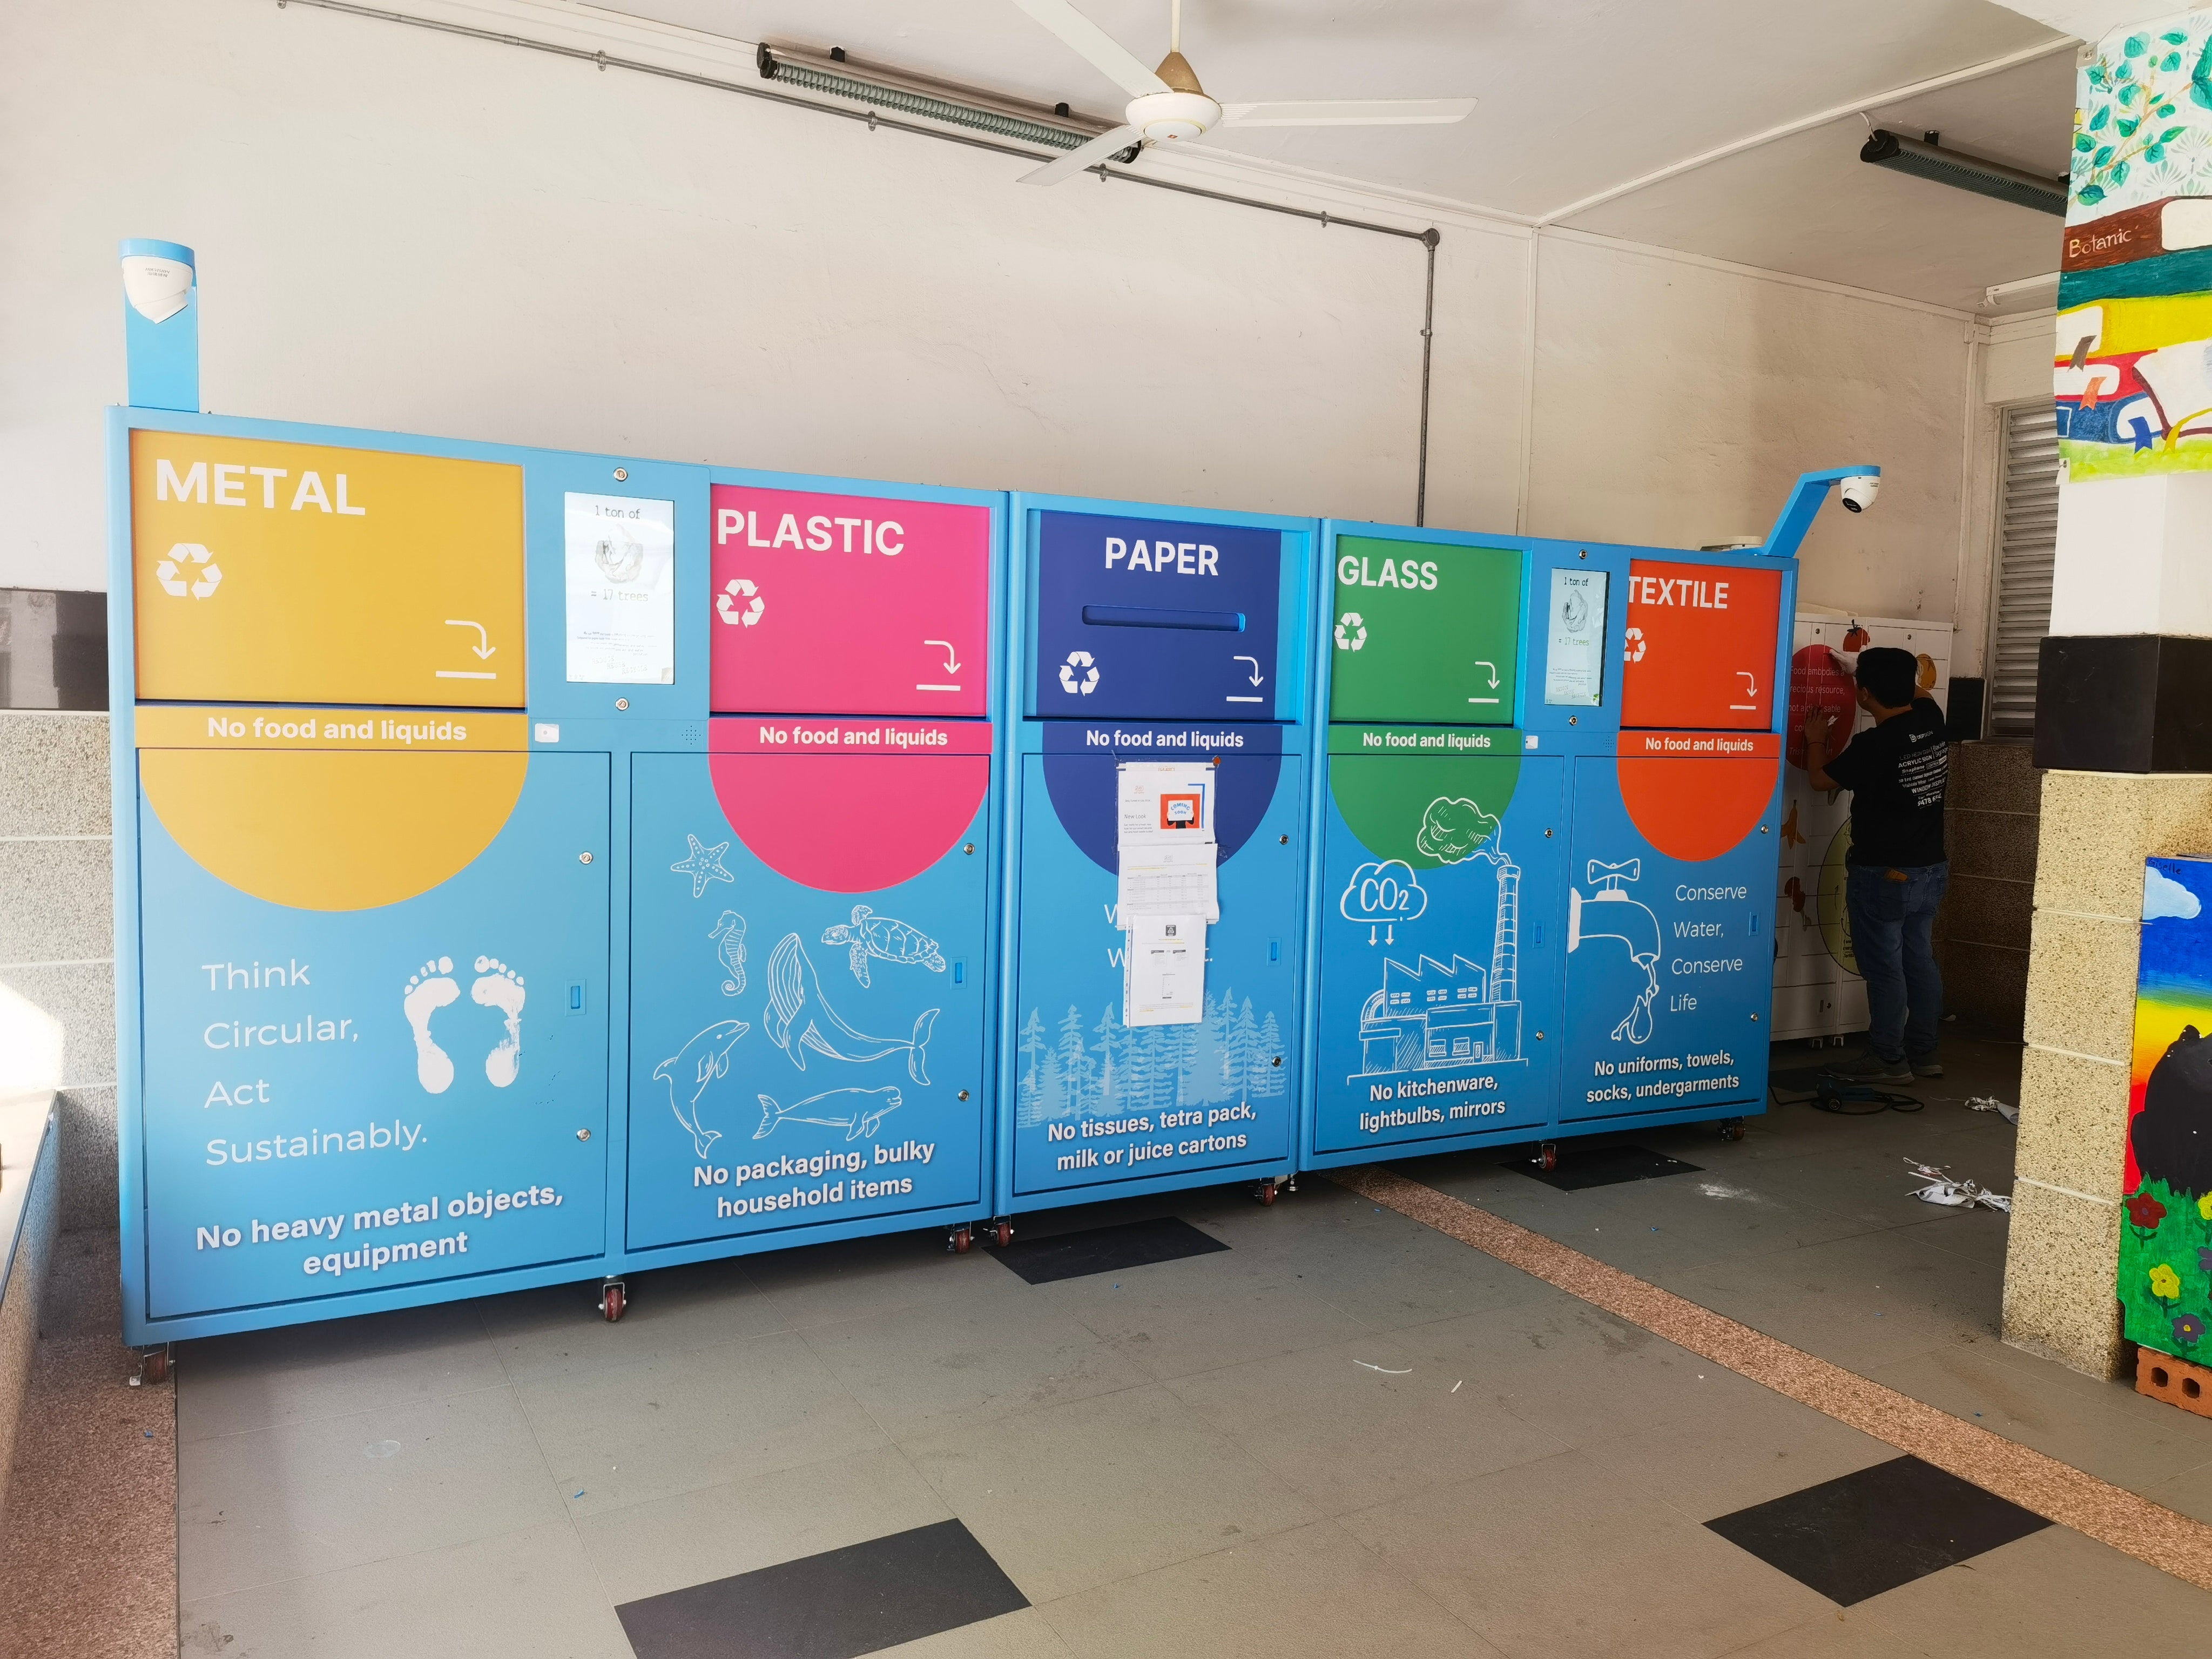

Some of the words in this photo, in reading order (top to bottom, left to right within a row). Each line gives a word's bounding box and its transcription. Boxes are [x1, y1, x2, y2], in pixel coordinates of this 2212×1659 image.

[2069, 228, 2132, 258] Botanic
[156, 458, 366, 515] METAL
[606, 507, 624, 518] ton
[629, 509, 640, 520] of
[718, 508, 905, 556] PLASTIC
[1105, 537, 1218, 576] PAPER
[1338, 555, 1438, 590] GLASS
[1570, 578, 1580, 586] ton
[1582, 578, 1589, 586] of
[603, 589, 614, 600] 17
[619, 590, 649, 602] trees
[1628, 576, 1729, 609] TEXTILE
[1564, 637, 1570, 645] 17
[1573, 638, 1589, 646] trees
[1808, 667, 1839, 676] embodies
[1790, 684, 1814, 693] recious
[1816, 686, 1845, 696] resource,
[208, 717, 245, 738] No
[253, 717, 316, 739] food
[323, 720, 373, 739] and
[381, 720, 467, 745] liquids
[759, 726, 787, 744] No
[792, 726, 838, 745] food
[844, 728, 880, 745] and
[885, 728, 948, 749] liquids
[1086, 730, 1110, 746] No
[1114, 730, 1152, 746] food
[1156, 731, 1186, 747] and
[1191, 731, 1243, 751] liquids
[1363, 732, 1382, 746] No
[1385, 732, 1417, 747] food
[1420, 734, 1445, 747] and
[1448, 733, 1491, 751] liquids
[1645, 737, 1661, 750] No
[1664, 737, 1690, 751] food
[1693, 738, 1714, 751] and
[1717, 738, 1754, 754] liquids
[1898, 758, 1922, 768] ACRYLIC
[1912, 784, 1931, 794] WINDOW
[1918, 798, 1932, 806] 9478
[1171, 802, 1190, 811] COMING
[1676, 885, 1747, 901] Conserve
[1674, 921, 1724, 938] Water,
[201, 959, 310, 991] Think
[1672, 958, 1743, 975] Conserve
[1670, 994, 1697, 1012] Life
[204, 1015, 358, 1049] Circular,
[1595, 1061, 1614, 1076] No
[1618, 1056, 1683, 1074] uniforms,
[1687, 1049, 1735, 1068] towels,
[204, 1079, 270, 1109] Act
[1370, 1084, 1392, 1101] No
[1397, 1076, 1498, 1098] kitchenware,
[1587, 1084, 1631, 1103] socks,
[1636, 1075, 1739, 1097] undergarments
[1048, 1123, 1075, 1142] No
[1081, 1116, 1155, 1138] tissues,
[1160, 1109, 1203, 1128] tetra
[1208, 1103, 1257, 1127] pack,
[1360, 1105, 1445, 1133] lightbulbs,
[1449, 1101, 1506, 1120] mirrors
[206, 1119, 427, 1165] Sustainably.
[1057, 1148, 1098, 1171] milk
[1104, 1148, 1124, 1165] or
[1128, 1141, 1174, 1166] juice
[1178, 1134, 1247, 1155] cartons
[694, 1165, 729, 1187] No
[736, 1150, 867, 1186] packaging,
[874, 1140, 935, 1164] bulky
[717, 1181, 843, 1218] household
[851, 1177, 912, 1200] items
[197, 1225, 241, 1250] No
[252, 1214, 345, 1243] heavy
[354, 1196, 438, 1230] metal
[448, 1185, 563, 1219] objects,
[303, 1231, 468, 1276] equipment
